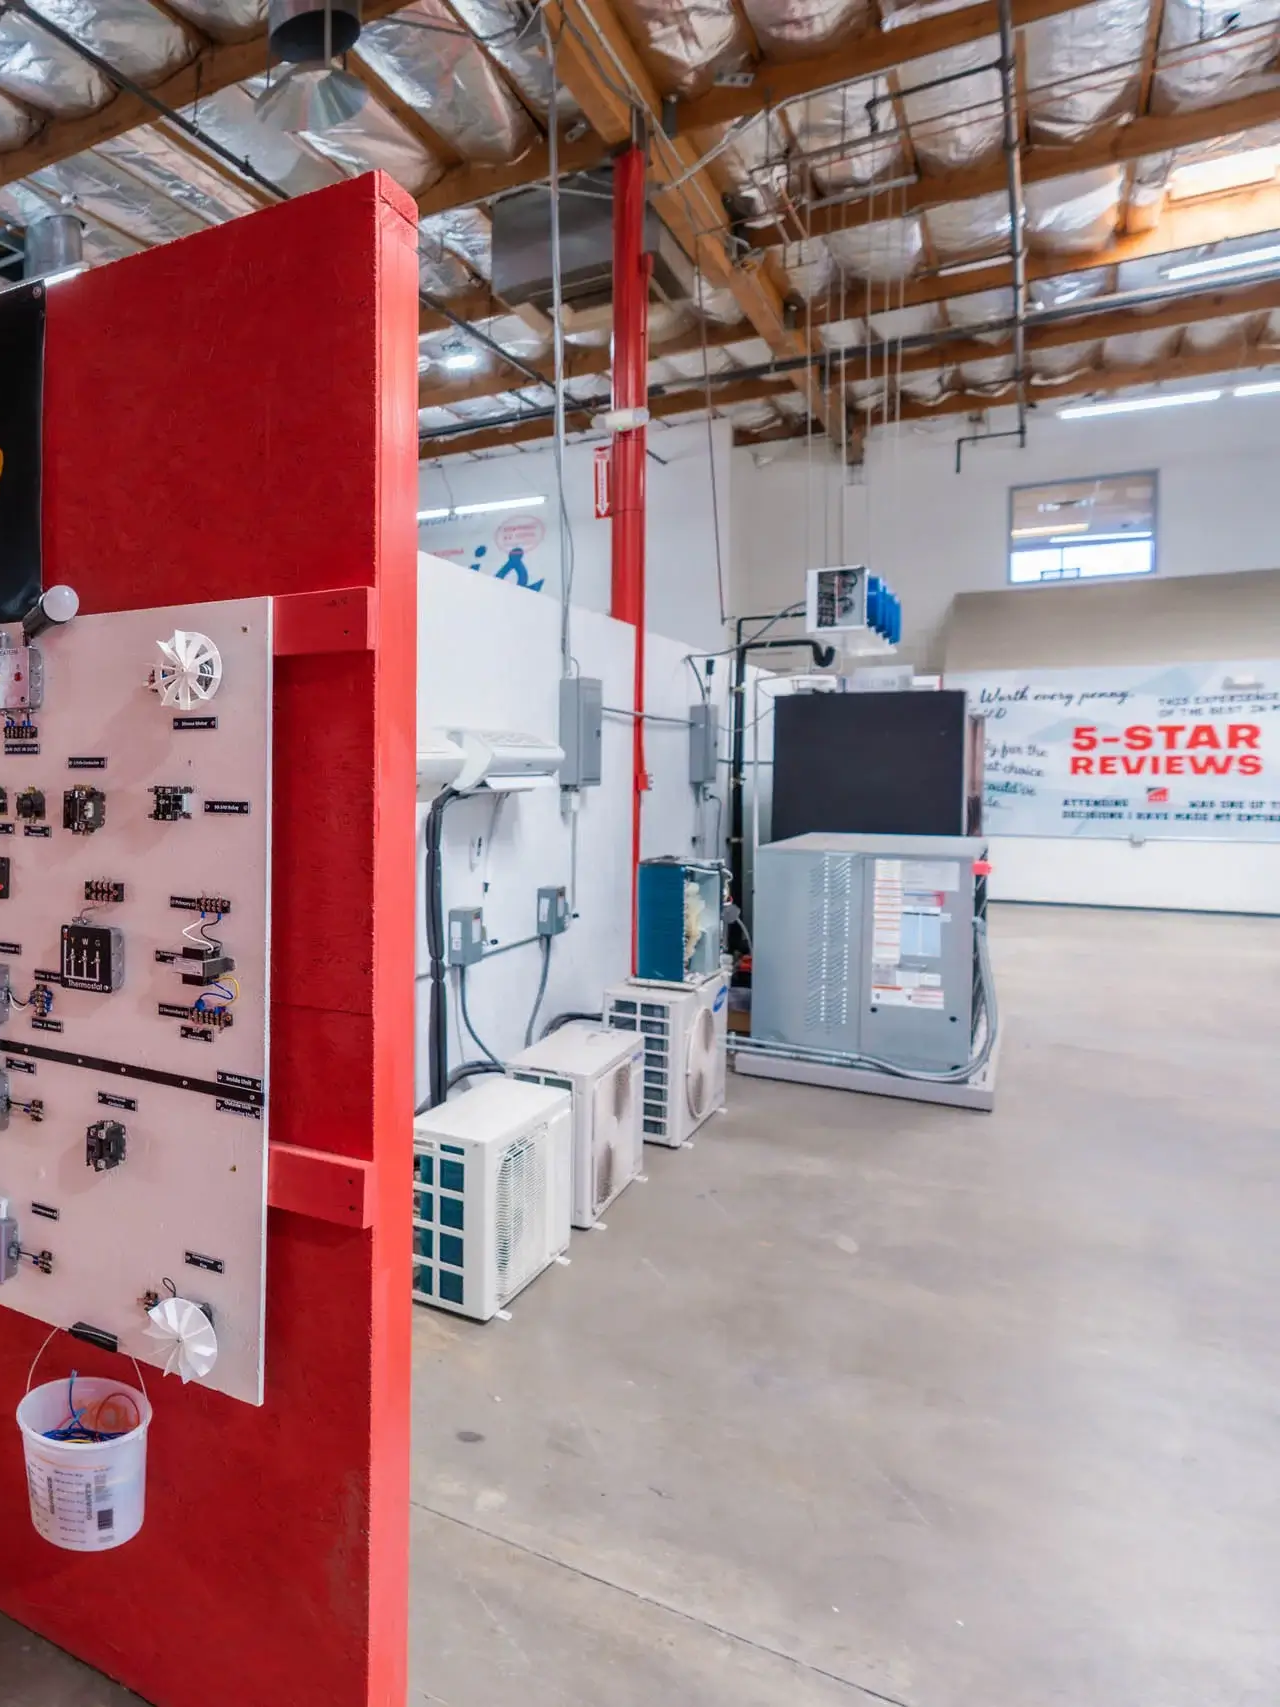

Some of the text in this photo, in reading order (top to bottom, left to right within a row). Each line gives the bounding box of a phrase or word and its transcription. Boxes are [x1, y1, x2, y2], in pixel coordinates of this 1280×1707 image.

[979, 685, 1030, 704] Worth
[1033, 692, 1074, 706] every
[1071, 724, 1263, 751] 5-STAR
[1070, 754, 1263, 776] REVIEWS
[68, 979, 103, 991] Thermostat
